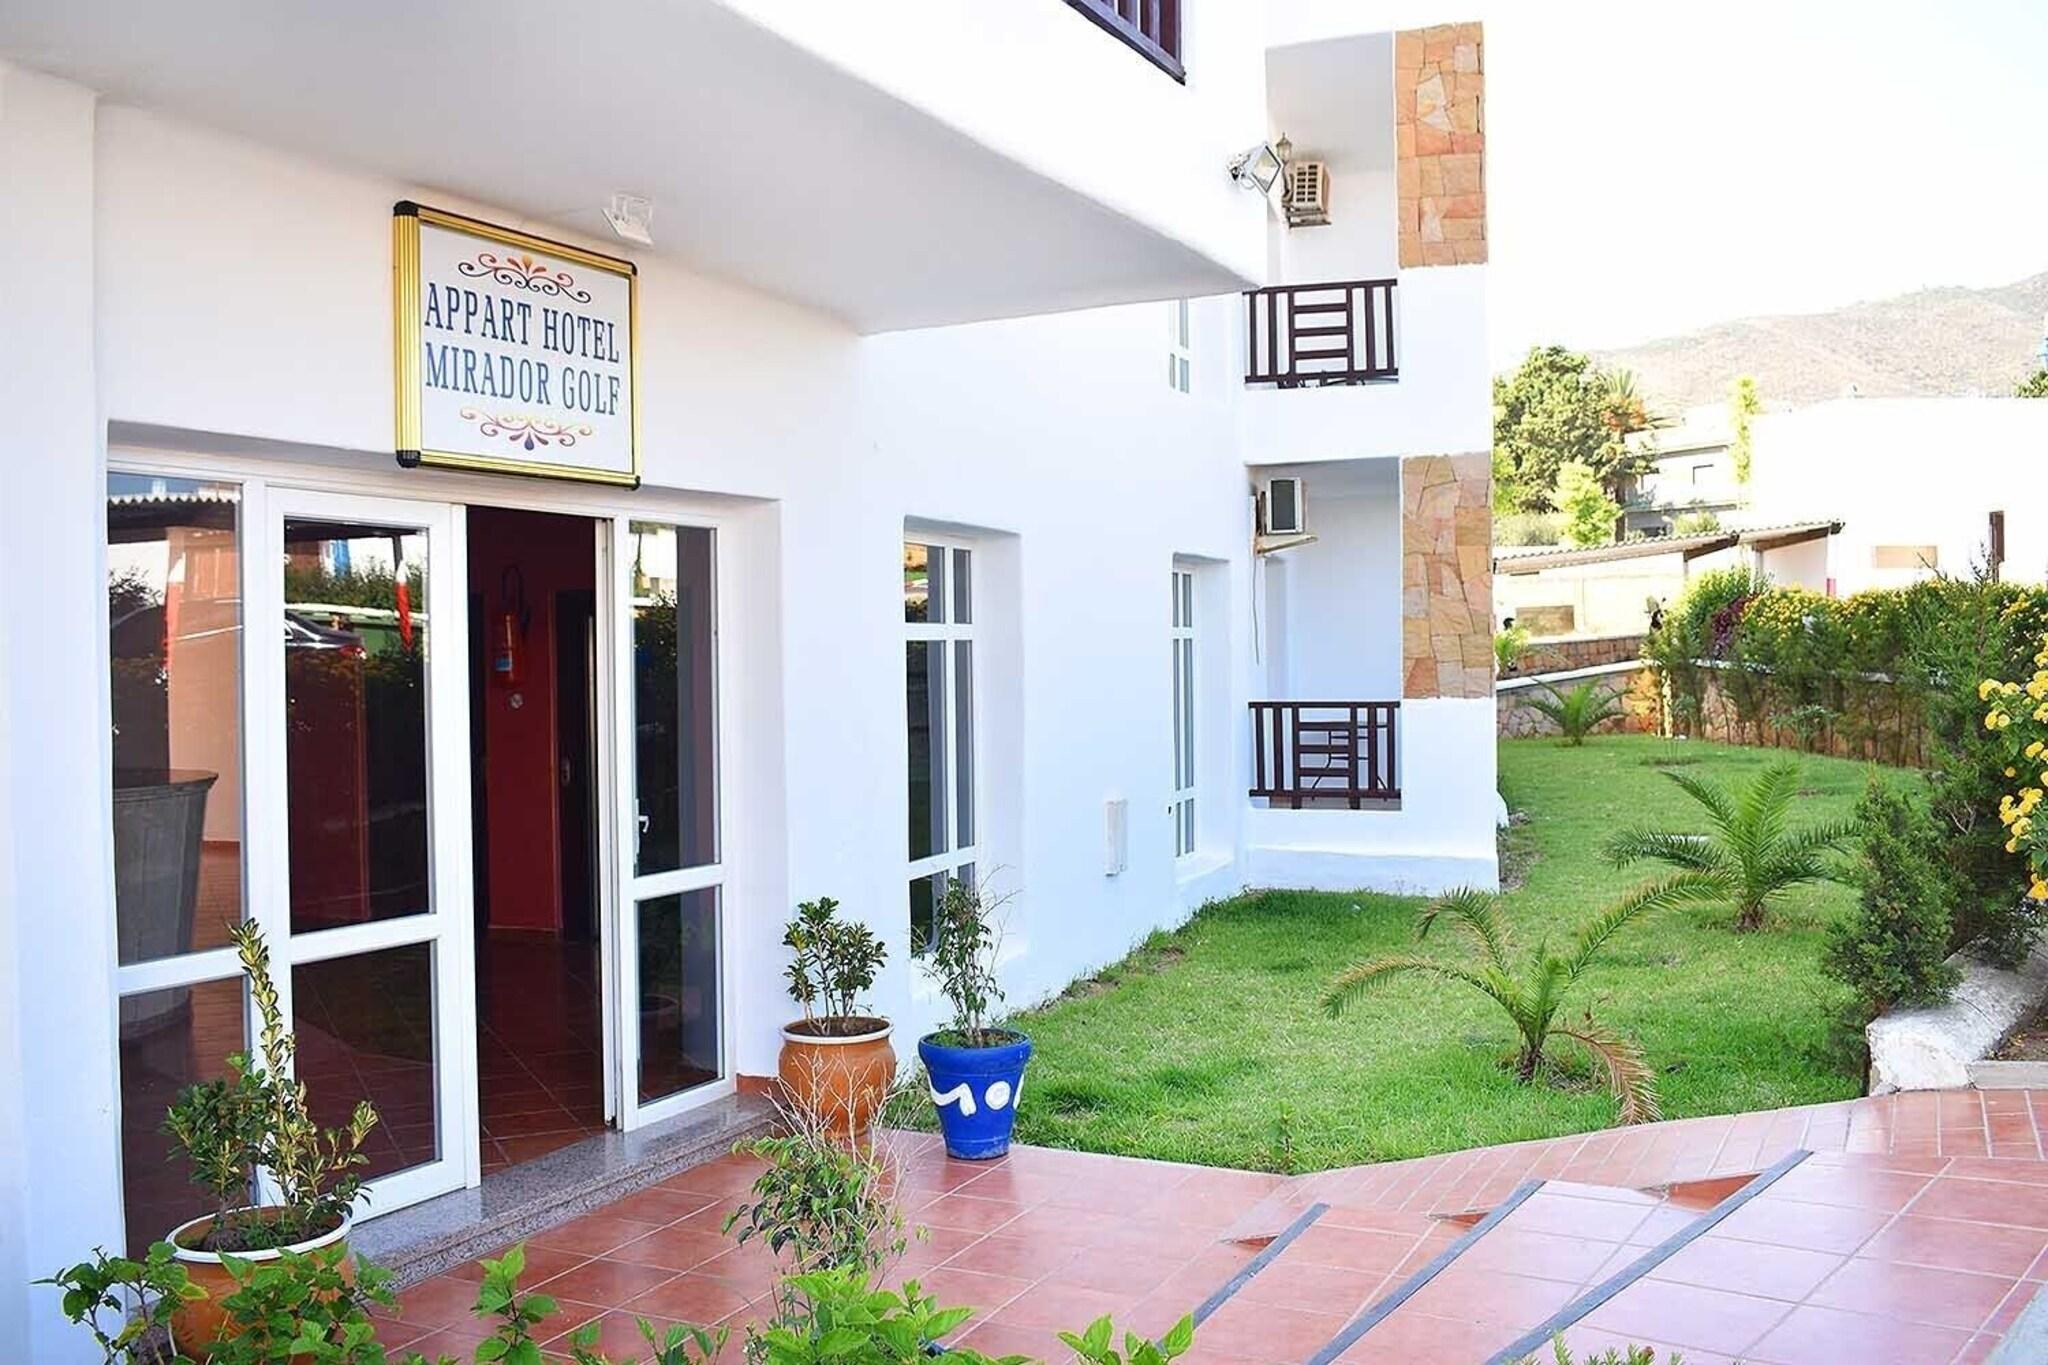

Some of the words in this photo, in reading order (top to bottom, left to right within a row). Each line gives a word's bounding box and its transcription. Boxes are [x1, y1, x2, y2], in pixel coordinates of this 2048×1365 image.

[424, 283, 532, 345] APPART
[542, 308, 620, 363] HOTEL
[425, 343, 551, 405] MIRADOR
[562, 367, 620, 416] GOLF
